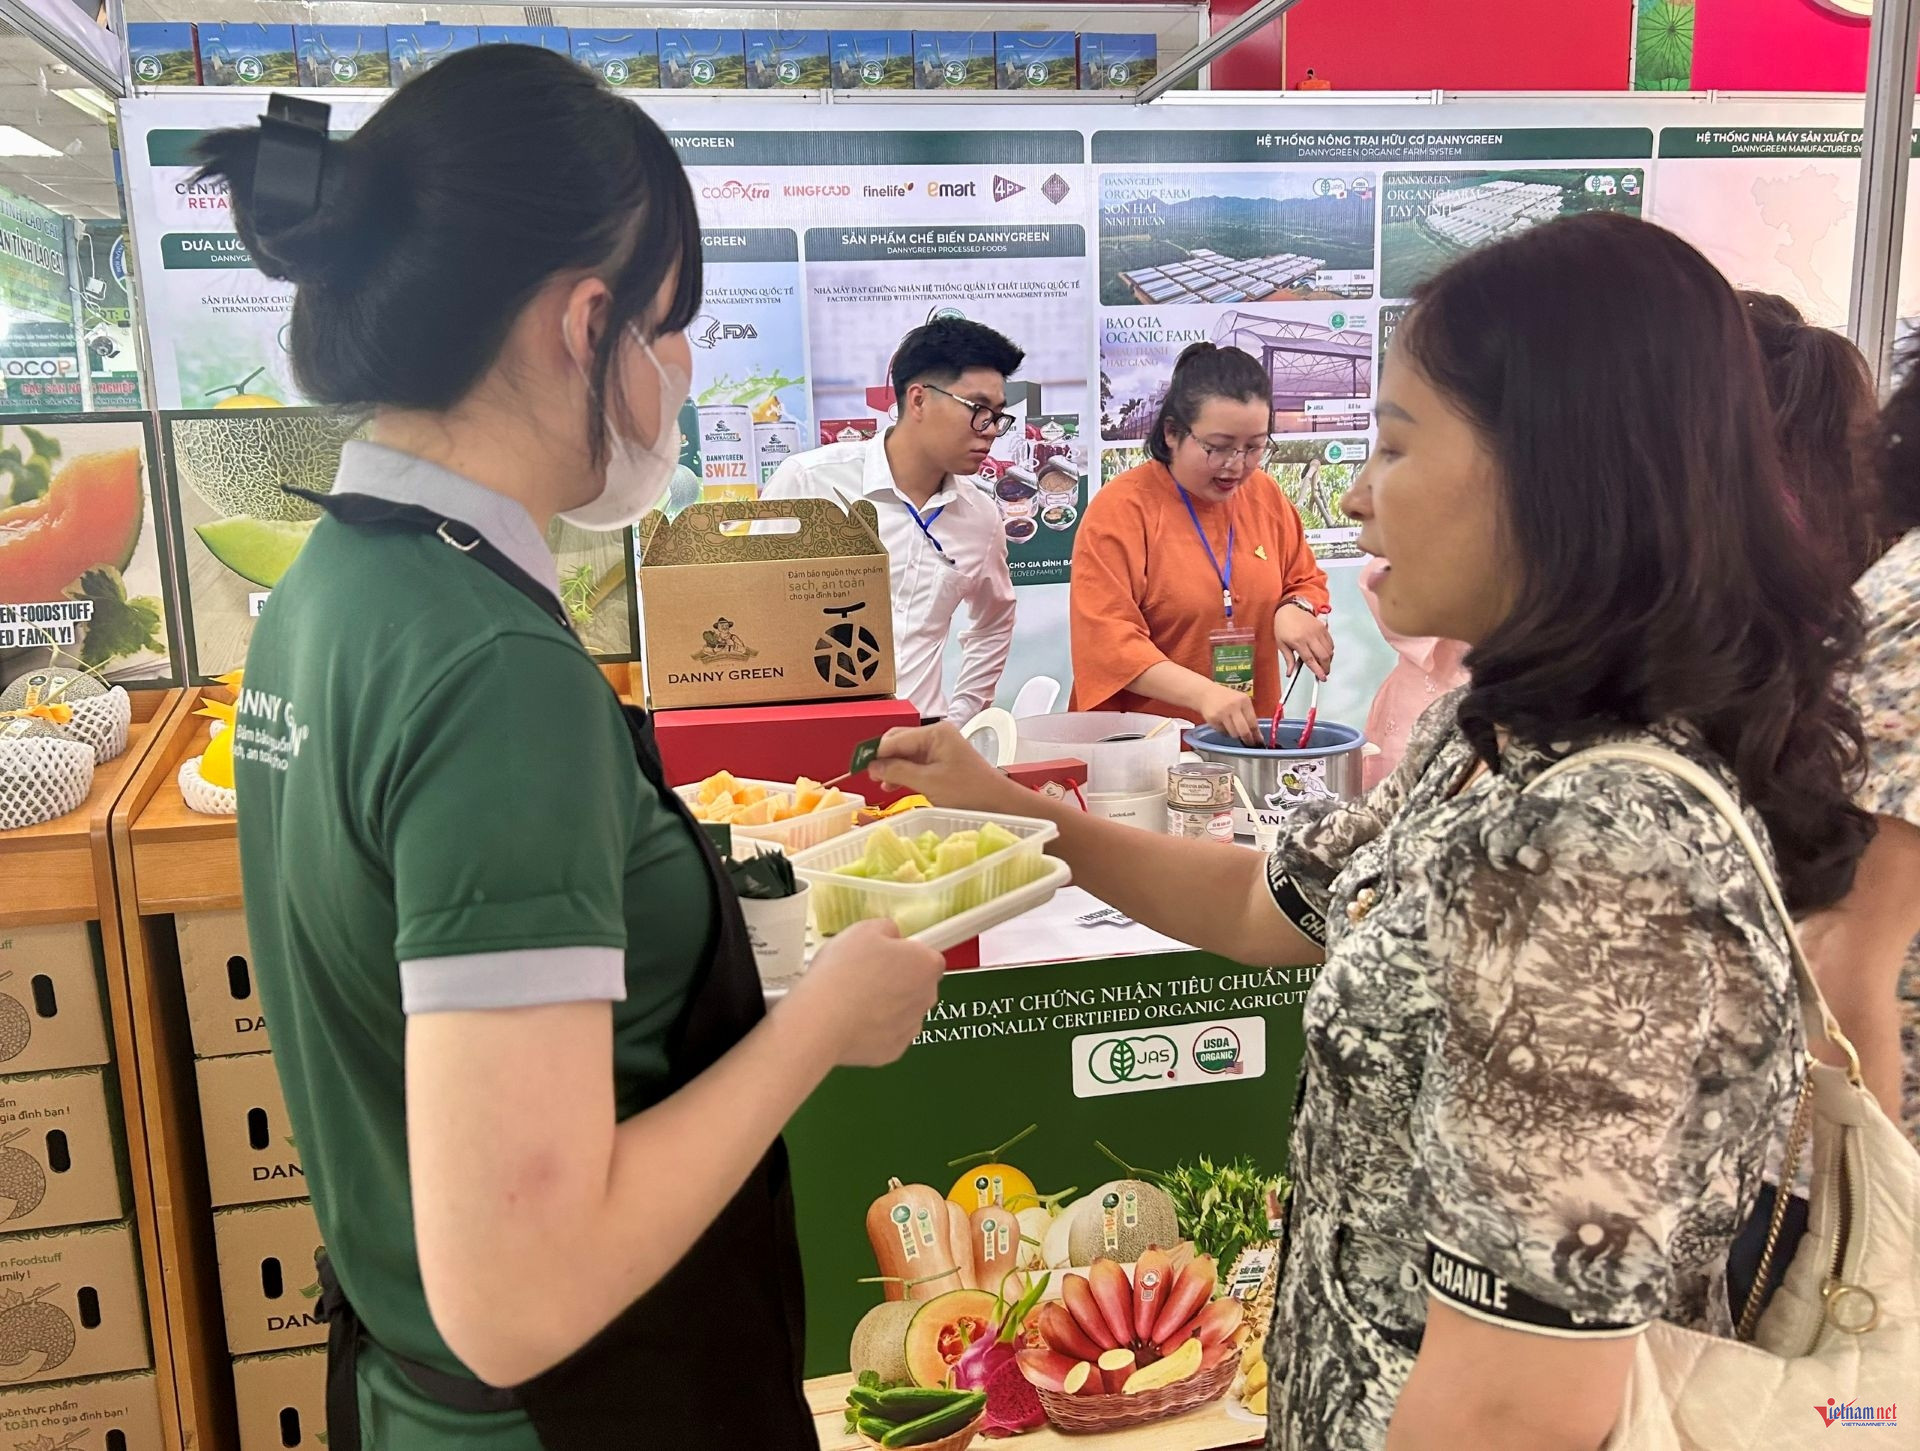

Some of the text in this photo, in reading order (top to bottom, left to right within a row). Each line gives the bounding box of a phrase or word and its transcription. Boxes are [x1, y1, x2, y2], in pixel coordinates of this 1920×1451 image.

[1256, 133, 1503, 148] HỆ THỐNG NÔNG TRẠI HỮU CƠ DANNYGREEN
[1696, 130, 1850, 144] HỆ THỐNG NHÀ MÁY SẢN XUẤT
[1298, 148, 1462, 156] DANNYGREEN ORGANIC FARM SYSTEM
[1388, 176, 1450, 184] DANNYGREEN
[784, 180, 976, 198] KINGFOOD finelife emart
[1104, 188, 1191, 200] ORGANIC FARM
[1387, 190, 1442, 200] ORGANIC
[1388, 204, 1452, 217] TAY NINH
[842, 230, 1050, 245] SẢN PHẨM CHẾ BIẾN DANNYGREEN
[182, 239, 214, 251] DƯA
[888, 246, 936, 254] DANNYGREEN
[814, 286, 831, 294] NHÀ
[967, 292, 994, 300] QUALITY
[1106, 316, 1162, 329] BAO GIA
[722, 324, 758, 339] FDA
[1106, 329, 1205, 344] OGANIC FARM
[7, 360, 72, 376] OCOP
[706, 454, 744, 462] DANNYGREEN
[705, 462, 748, 478] SWIZZ
[822, 581, 836, 590] an
[840, 578, 864, 588] toàn
[790, 592, 802, 600] cho
[804, 593, 814, 601] gia
[20, 603, 90, 622] FOODSTUFF
[18, 626, 72, 645] FAMILY!
[668, 666, 784, 684] DANNY GREEN
[973, 998, 1014, 1018] ĐẠT
[1020, 989, 1095, 1012] CHỨNG
[1101, 982, 1162, 1004] NHẬN
[1168, 976, 1213, 996] TIÊU
[1219, 966, 1290, 991] CHUẨN
[1052, 1007, 1140, 1030] CERTIFIED
[1144, 998, 1225, 1018] ORGANIC
[1204, 1038, 1230, 1049] USDA
[1137, 1049, 1233, 1064] JAS ORGANIC
[18, 1109, 42, 1120] đình
[44, 1108, 64, 1117] bạn
[10, 1252, 62, 1266] Foodstuff
[1432, 1251, 1508, 1310] CHANLE
[23, 1407, 46, 1415] thực
[49, 1400, 78, 1414] phẩm
[6, 1410, 123, 1431] toàn cho gia đình bạn
